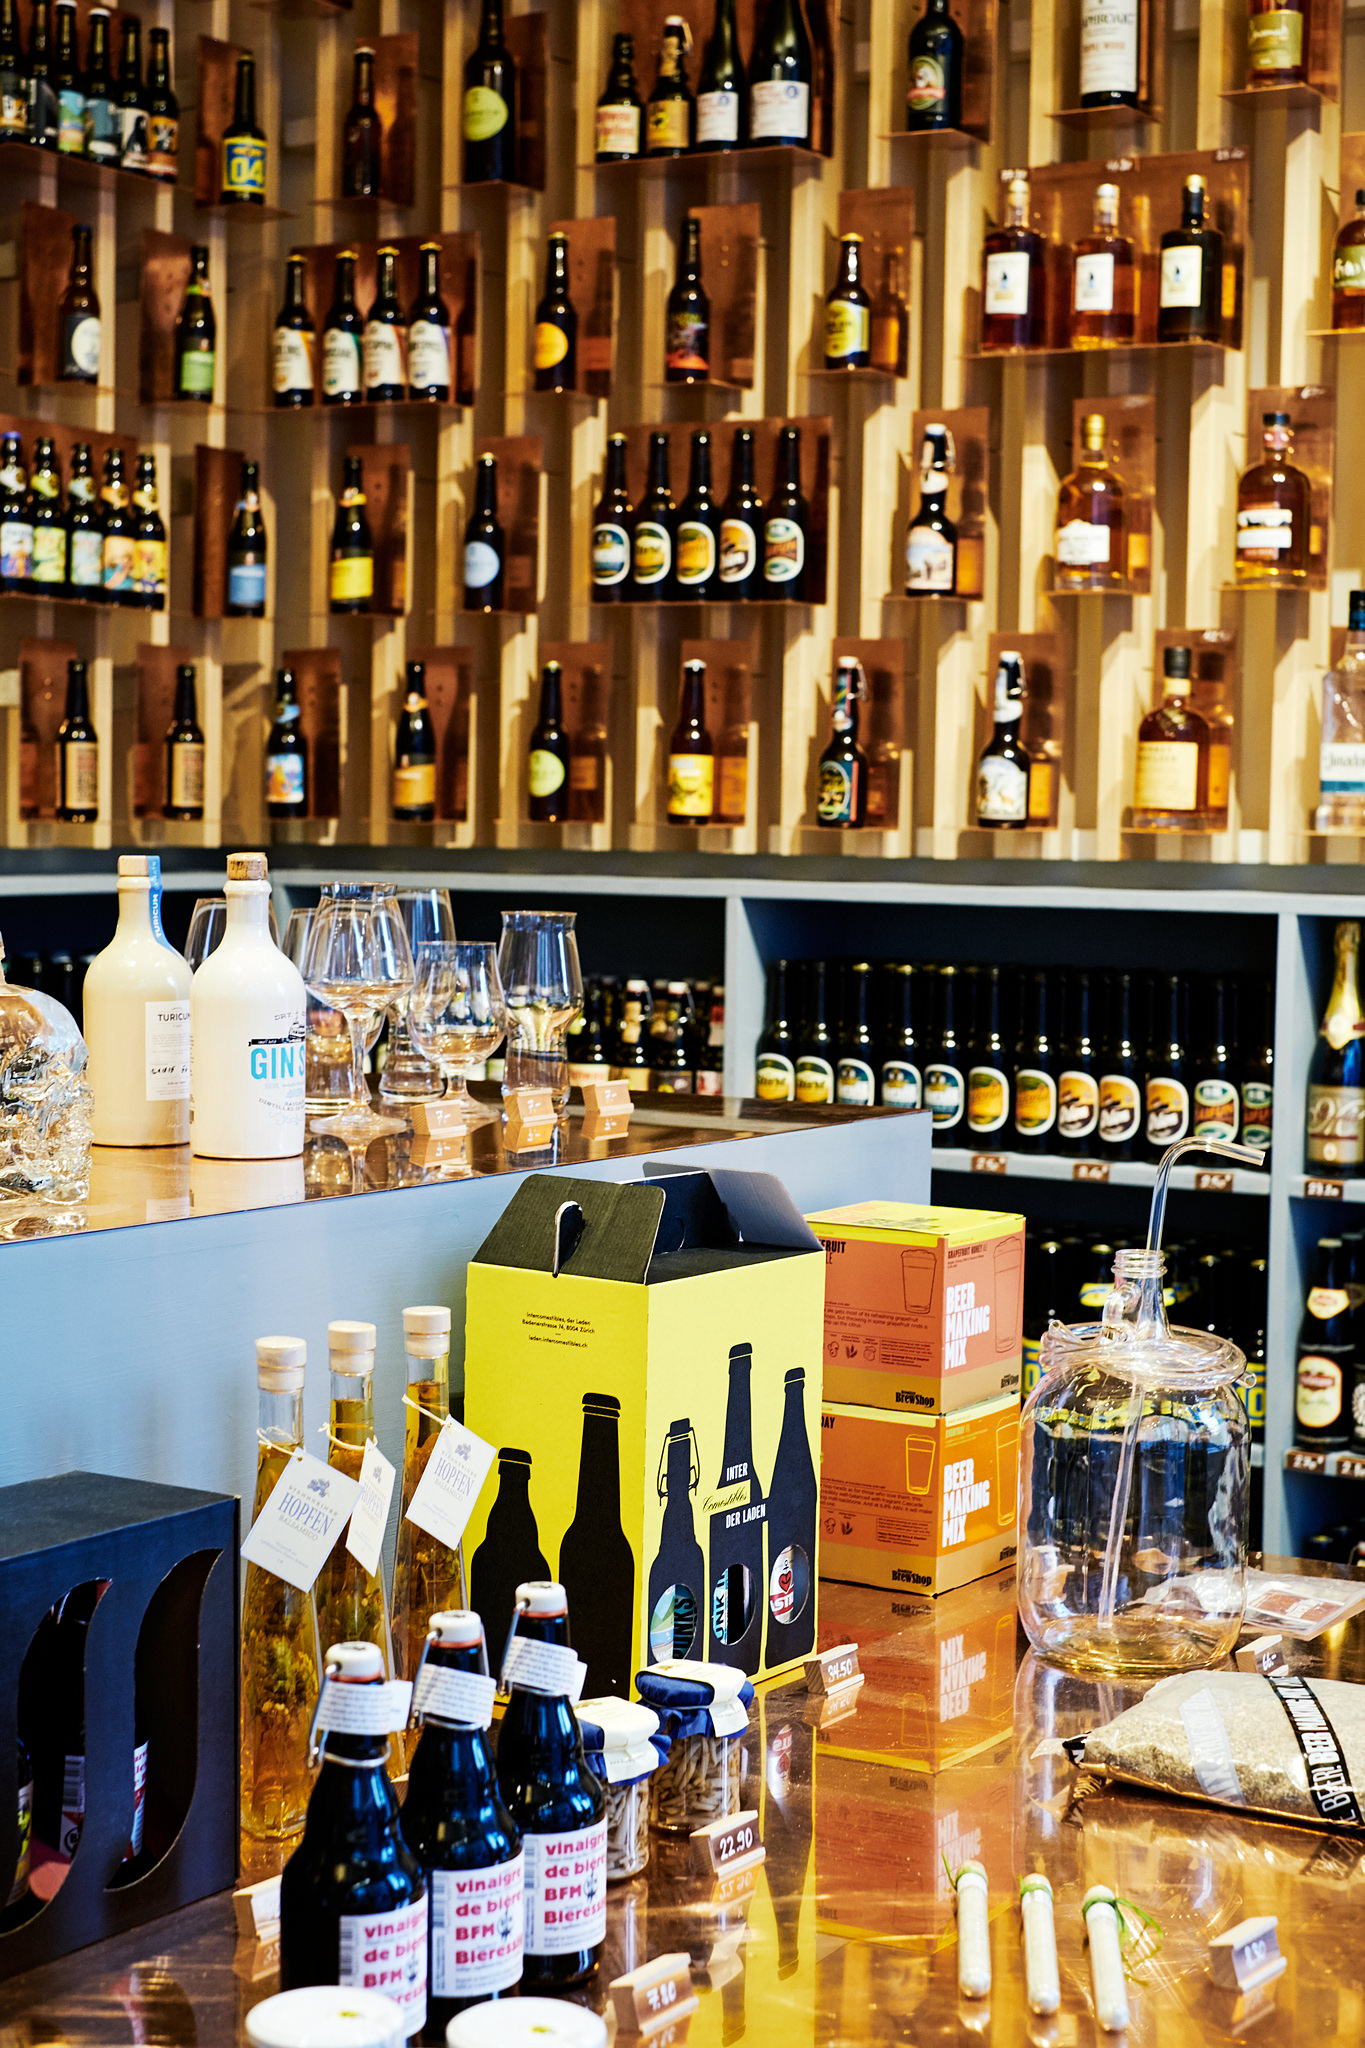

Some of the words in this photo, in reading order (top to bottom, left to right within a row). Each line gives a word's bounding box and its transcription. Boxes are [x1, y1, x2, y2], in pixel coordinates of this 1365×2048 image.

[152, 893, 162, 939] TURICUM
[250, 1046, 294, 1080] GIN
[946, 1281, 975, 1315] BEER
[945, 1304, 990, 1342] MAKING
[944, 1337, 967, 1370] MIX
[434, 1457, 475, 1497] HOPFEN
[726, 1462, 748, 1482] INTER
[944, 1458, 974, 1493] BEER
[278, 1491, 335, 1537] HOPFEN
[702, 1486, 748, 1513] Comestibles
[725, 1512, 741, 1529] DER
[742, 1503, 766, 1524] LADEN
[943, 1480, 990, 1521] MAKING
[942, 1514, 967, 1548] MIX
[827, 1658, 853, 1683] 34.50
[1301, 1731, 1340, 1766] BEER
[1311, 1764, 1352, 1812] BEER!
[719, 1827, 753, 1861] 22.90
[545, 1865, 570, 1878] de
[544, 1884, 582, 1901] BFM
[455, 1903, 482, 1917] de
[455, 1923, 495, 1941] BFM
[363, 1949, 390, 1963] de
[363, 1968, 403, 1989] BFM
